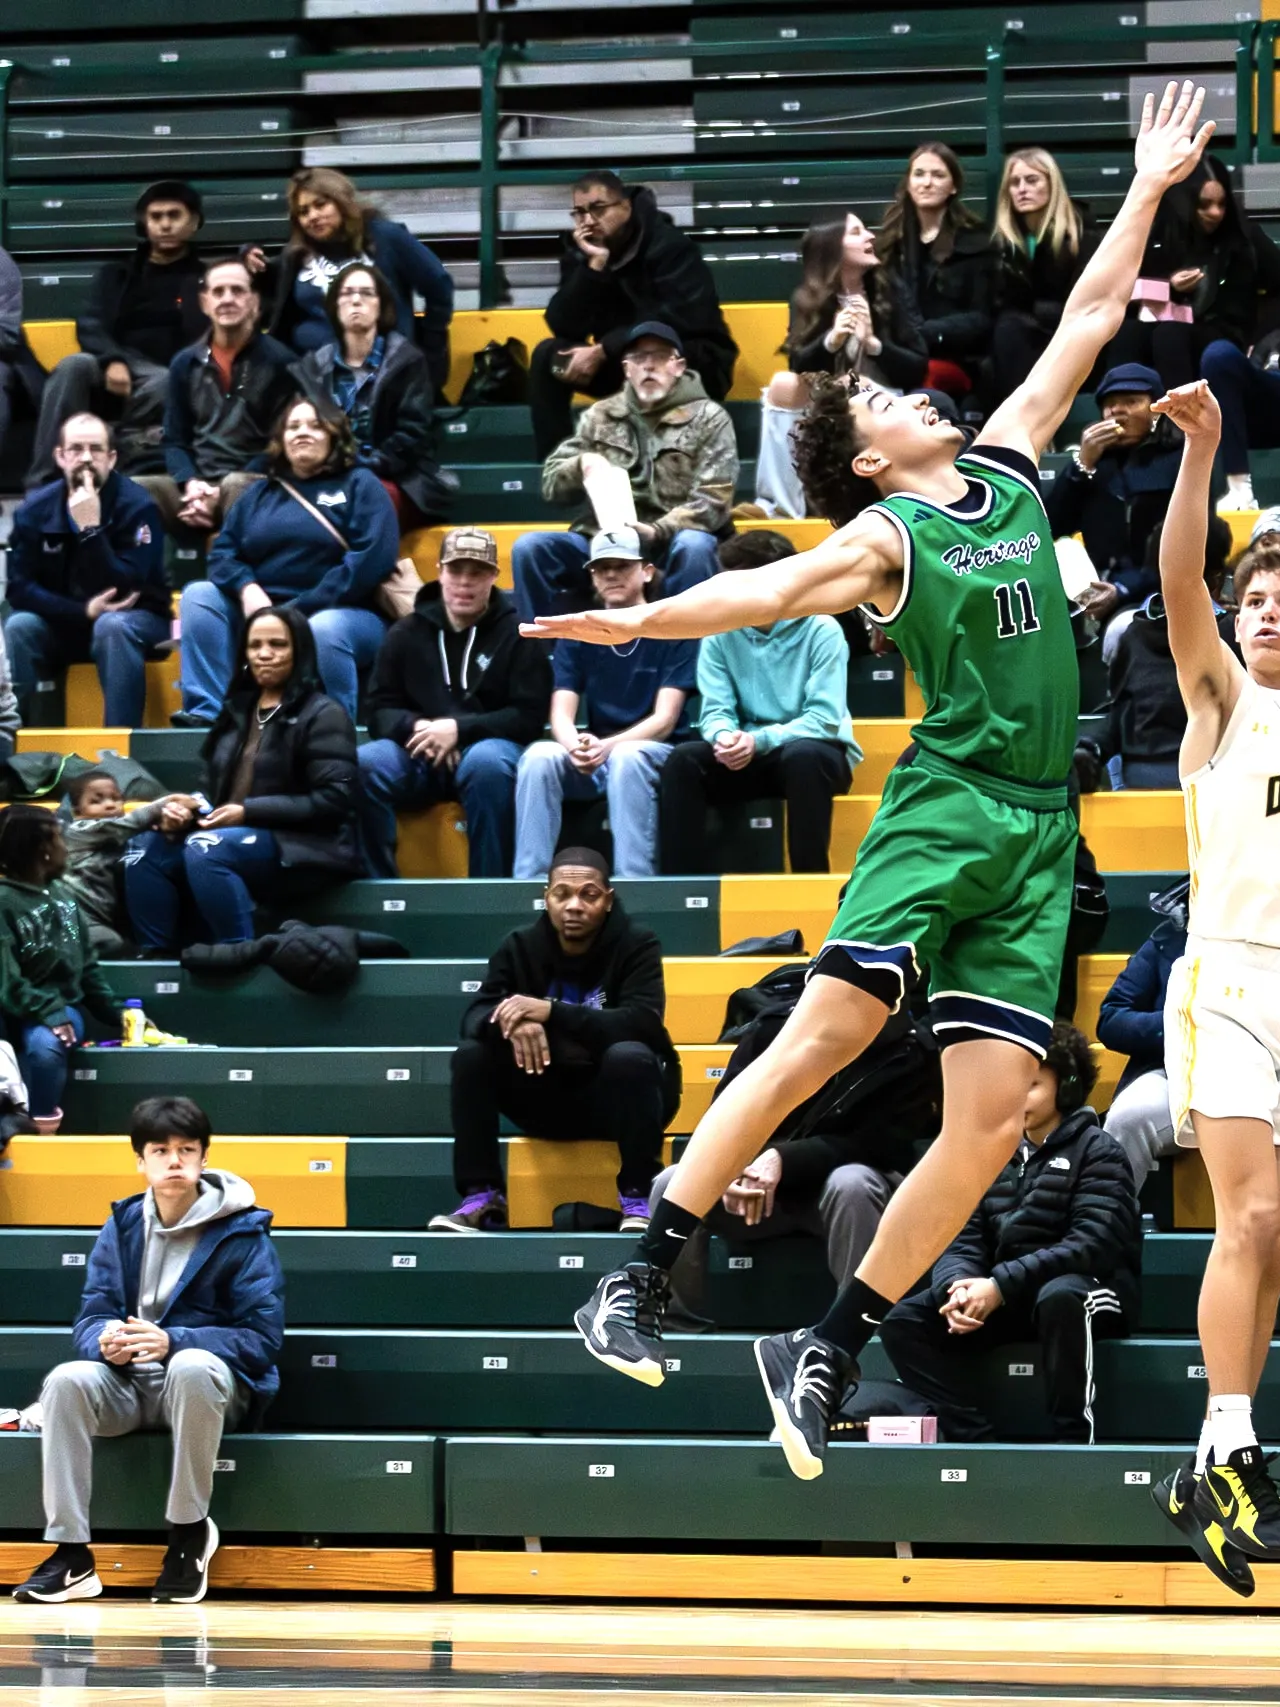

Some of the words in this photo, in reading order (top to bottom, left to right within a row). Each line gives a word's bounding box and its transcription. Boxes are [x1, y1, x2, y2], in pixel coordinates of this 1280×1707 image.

[941, 532, 1041, 576] Heritage
[993, 578, 1041, 638] 11
[948, 1471, 960, 1479] 33
[1131, 1473, 1143, 1482] 34
